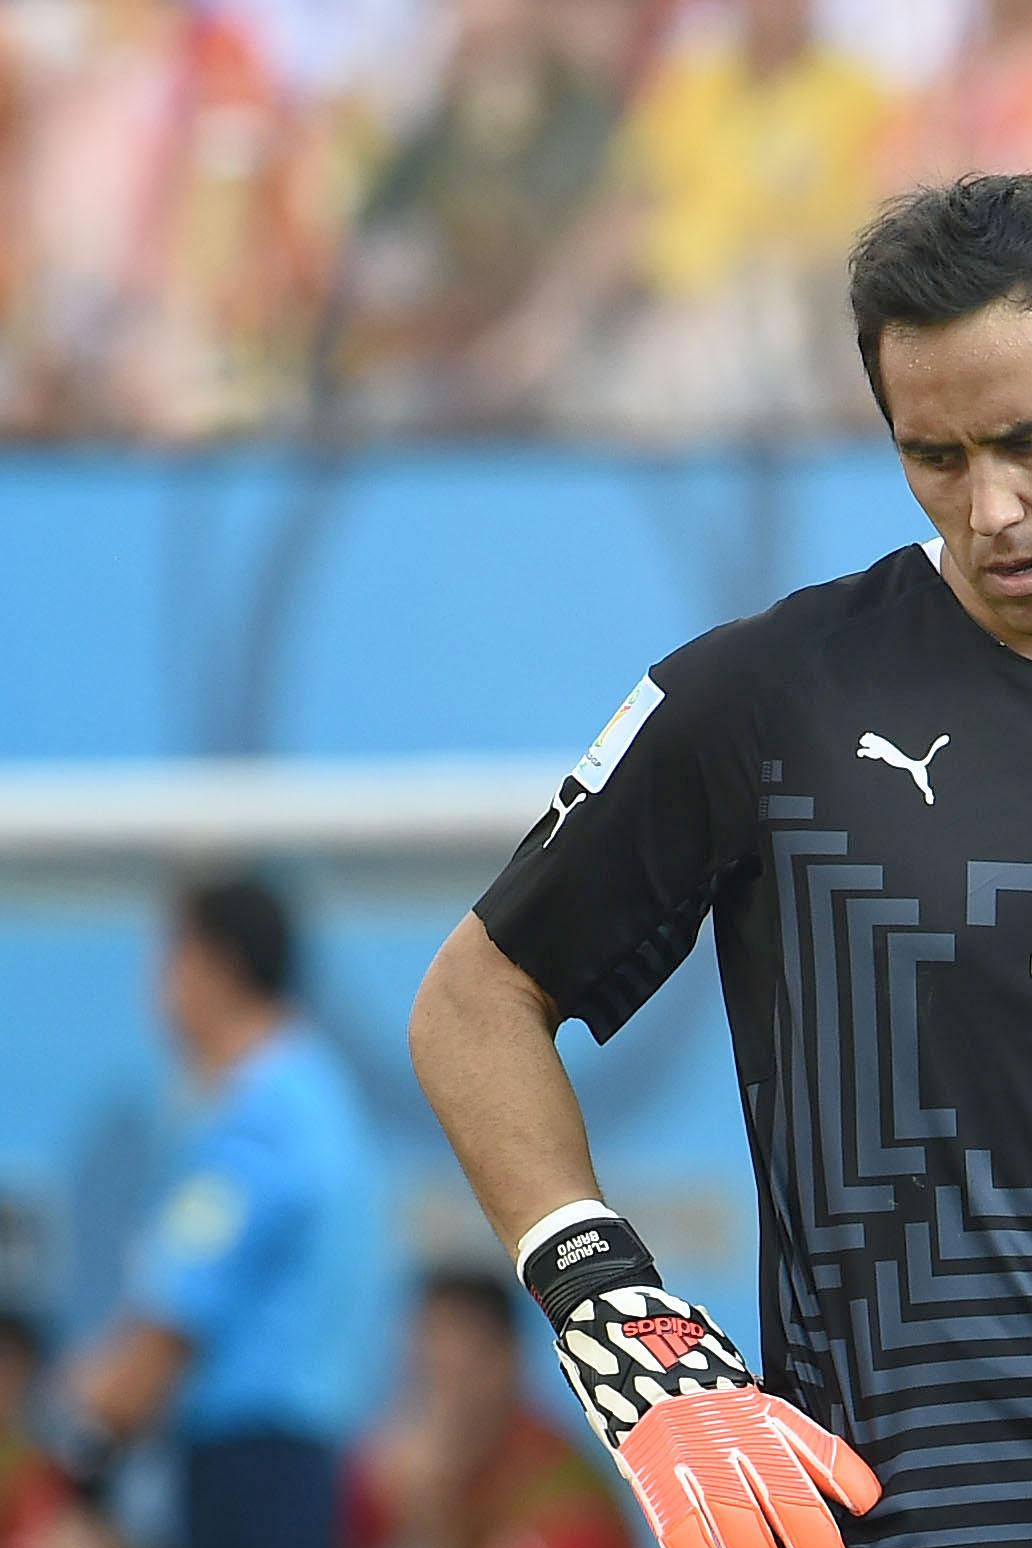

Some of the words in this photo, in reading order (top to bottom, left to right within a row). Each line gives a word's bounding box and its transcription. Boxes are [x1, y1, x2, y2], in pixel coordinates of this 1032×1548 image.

[556, 1240, 610, 1271] CLAUDIO
[557, 1230, 600, 1256] BRAVO
[622, 1317, 705, 1339] adidas
